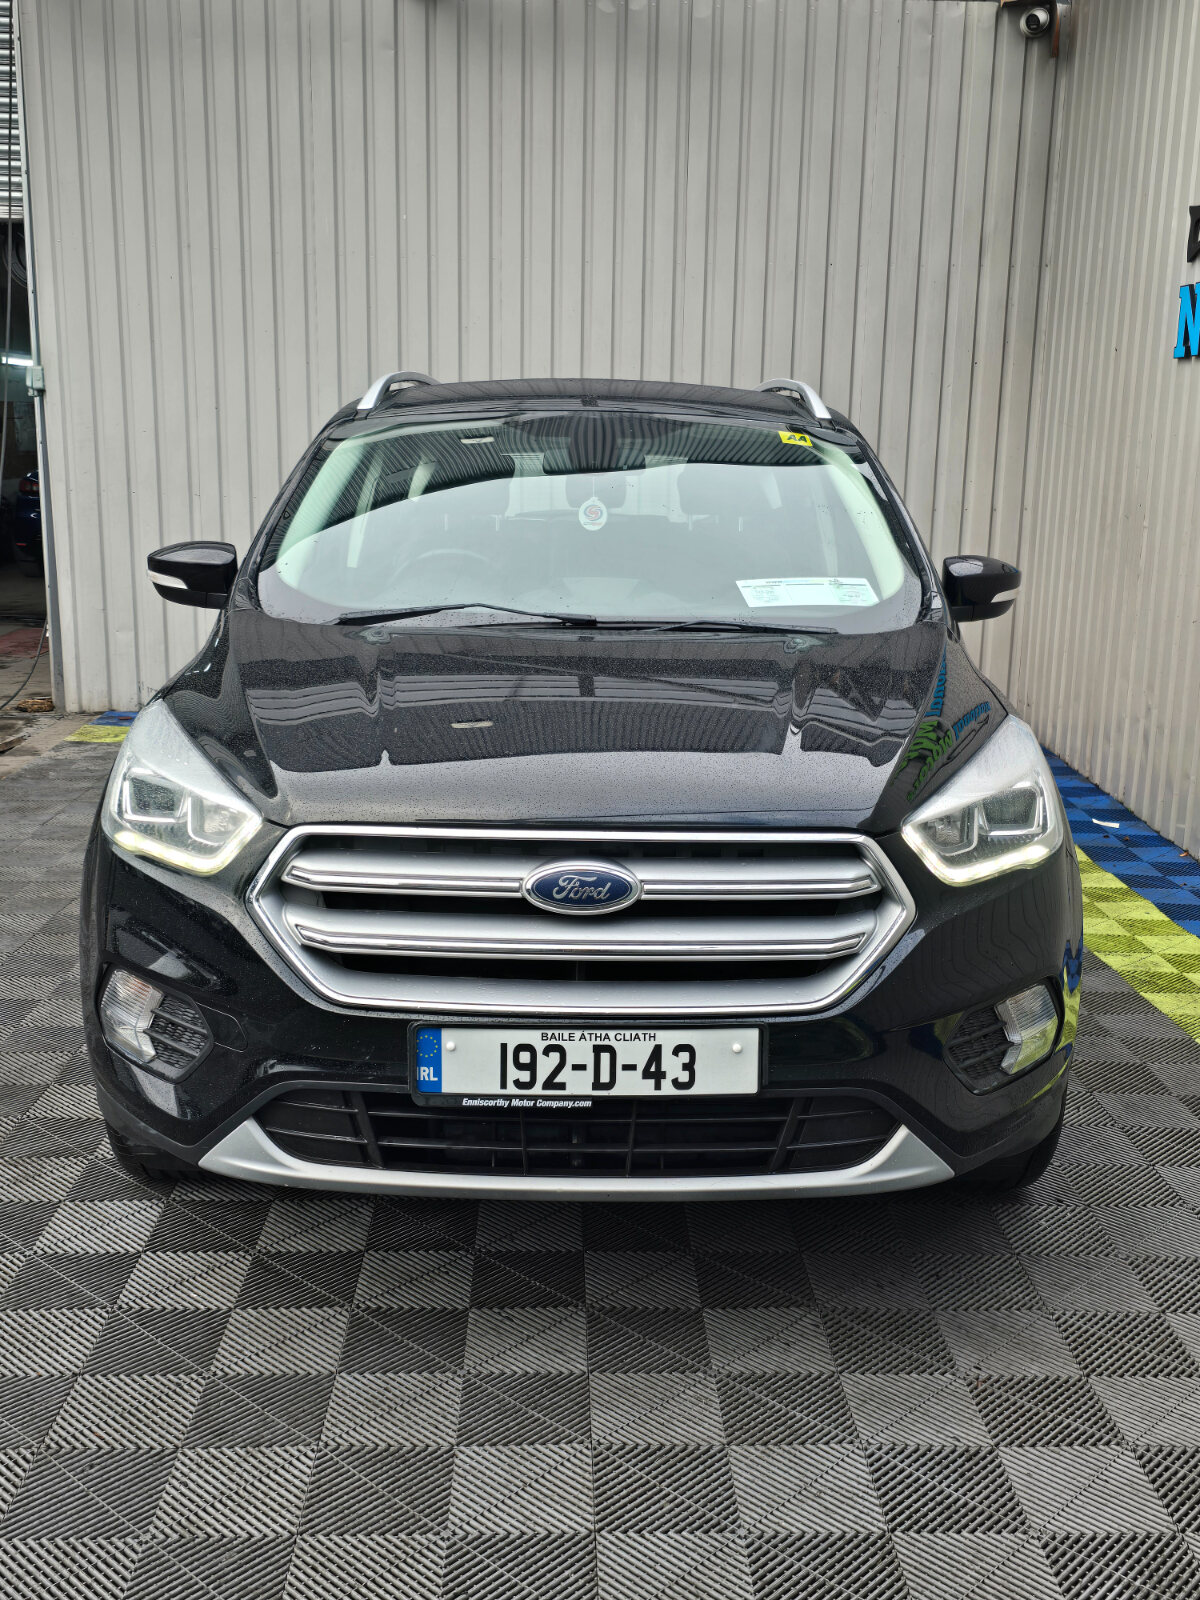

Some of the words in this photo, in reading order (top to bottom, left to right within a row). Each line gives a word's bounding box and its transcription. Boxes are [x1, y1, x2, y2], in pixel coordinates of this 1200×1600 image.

[787, 434, 807, 443] AA
[552, 874, 612, 900] Ford
[541, 1032, 575, 1042] BAILE
[579, 1030, 611, 1042] ÁTHA
[614, 1032, 656, 1042] CLIATH
[500, 1043, 696, 1091] 192-D-43
[462, 1098, 509, 1108] Enniscorthy
[511, 1098, 535, 1107] Motor
[536, 1099, 592, 1109] Company.com
